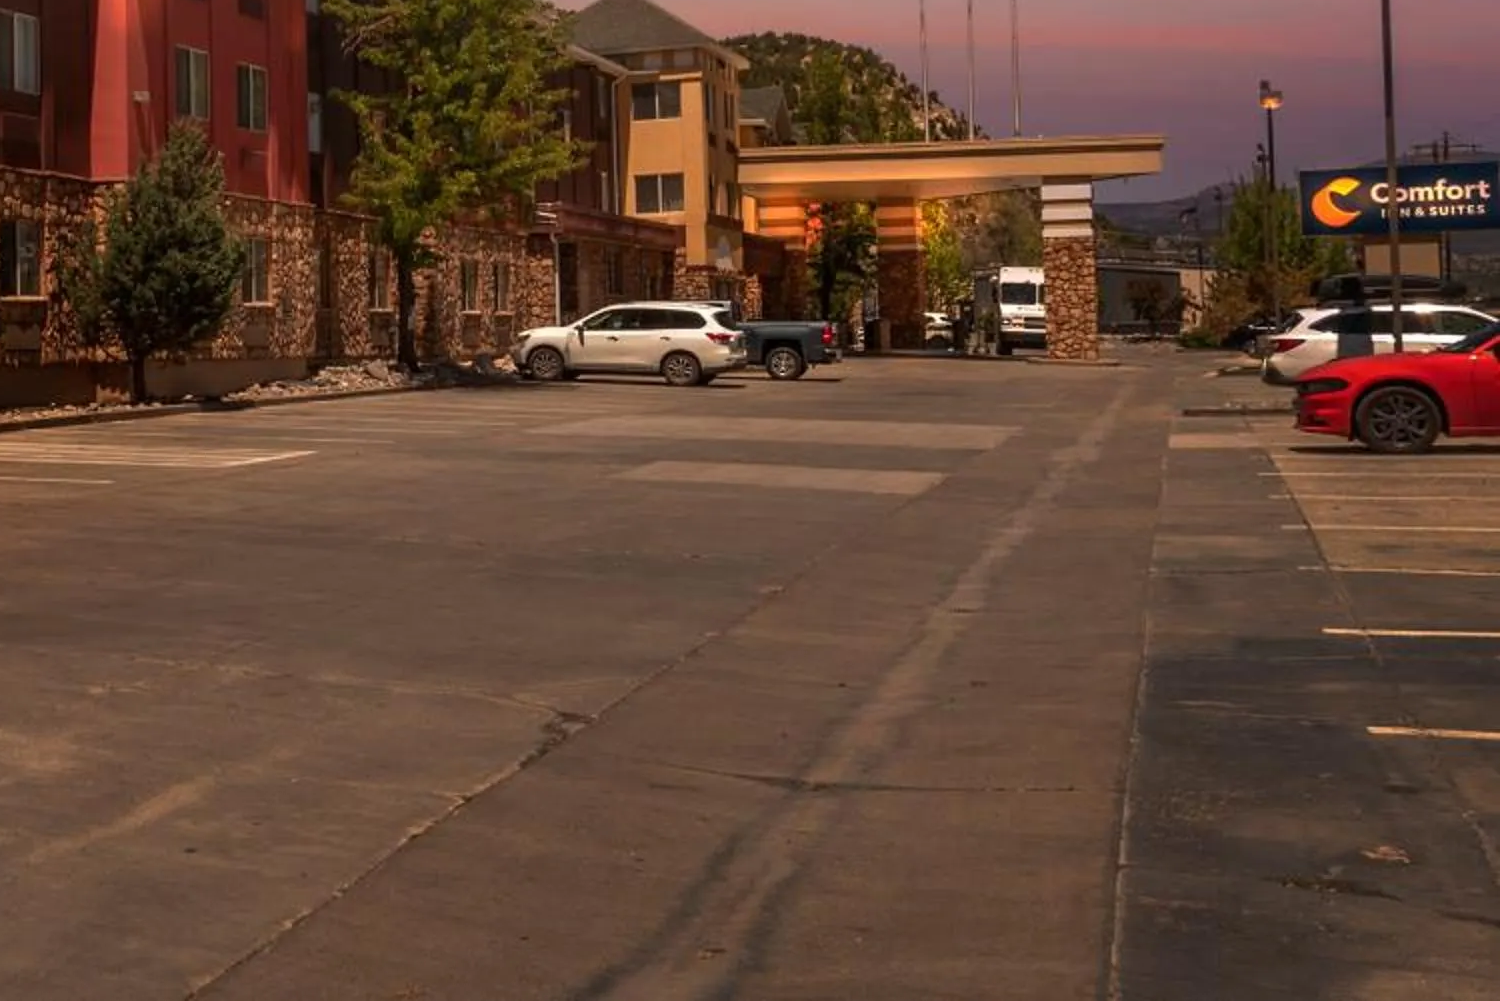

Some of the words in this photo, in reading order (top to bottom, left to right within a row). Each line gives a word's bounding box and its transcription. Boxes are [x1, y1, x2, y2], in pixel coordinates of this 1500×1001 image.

[1370, 177, 1491, 204] Comfort
[1381, 206, 1411, 219] IN
[1414, 205, 1425, 218] &
[1428, 203, 1486, 217] SUITES
